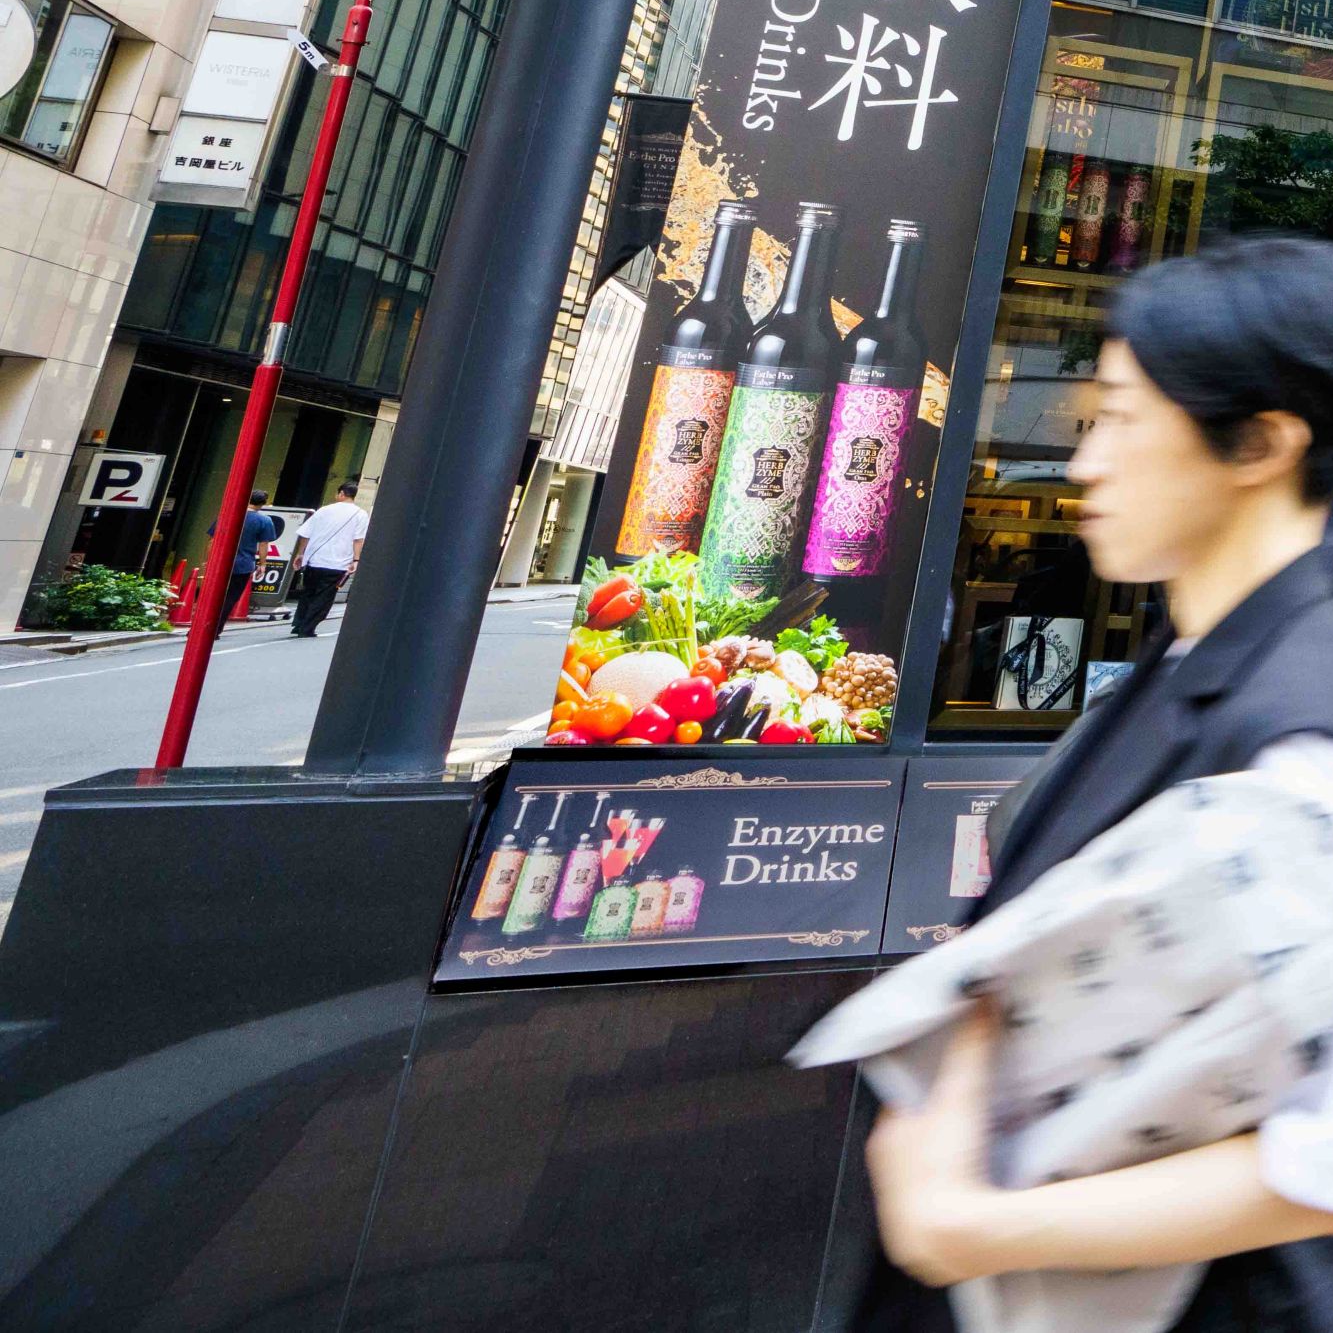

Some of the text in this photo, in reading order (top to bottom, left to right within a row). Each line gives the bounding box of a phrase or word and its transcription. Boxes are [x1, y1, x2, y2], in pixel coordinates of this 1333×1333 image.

[298, 41, 315, 60] 5m
[698, 353, 713, 361] Pro
[778, 372, 794, 380] Pro
[871, 370, 885, 379] Pro
[679, 431, 703, 440] HERB
[677, 438, 702, 447] ZYME
[853, 449, 877, 457] HERB
[851, 456, 877, 464] ZYME
[758, 461, 784, 470] HERB
[755, 468, 782, 477] ZYME
[727, 816, 885, 850] Enzyme
[719, 853, 858, 887] Drinks
